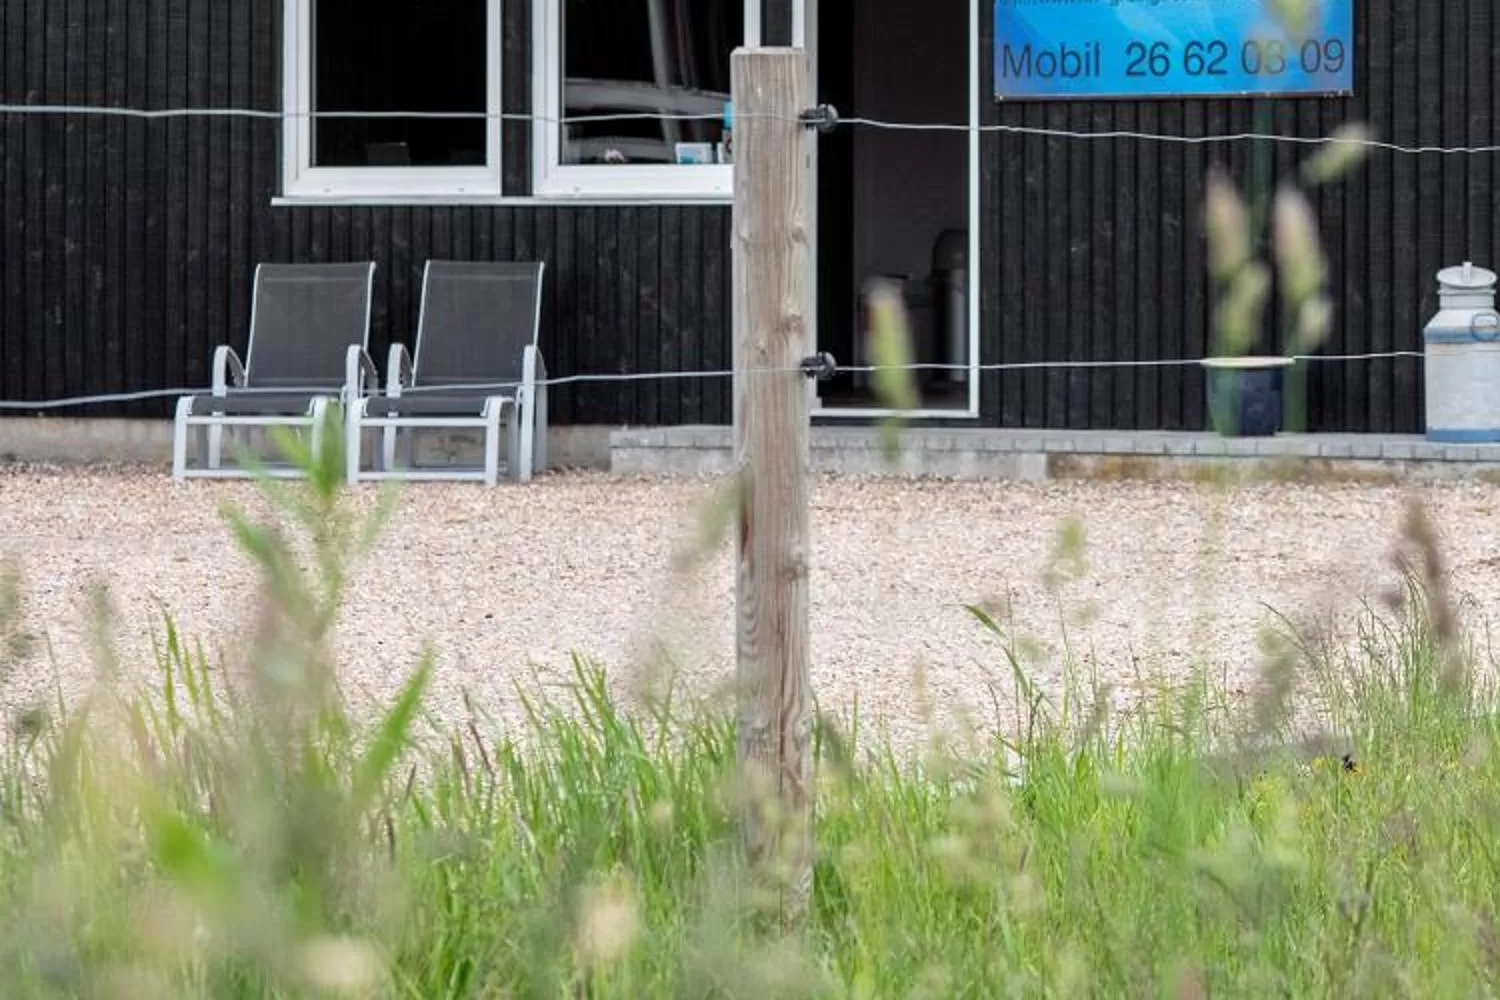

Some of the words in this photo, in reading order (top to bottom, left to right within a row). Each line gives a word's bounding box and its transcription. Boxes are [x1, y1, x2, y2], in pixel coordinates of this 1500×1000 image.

[1002, 42, 1100, 79] Mobil
[1124, 41, 1170, 78] 26
[1183, 40, 1228, 77] 62
[1301, 38, 1345, 74] 09
